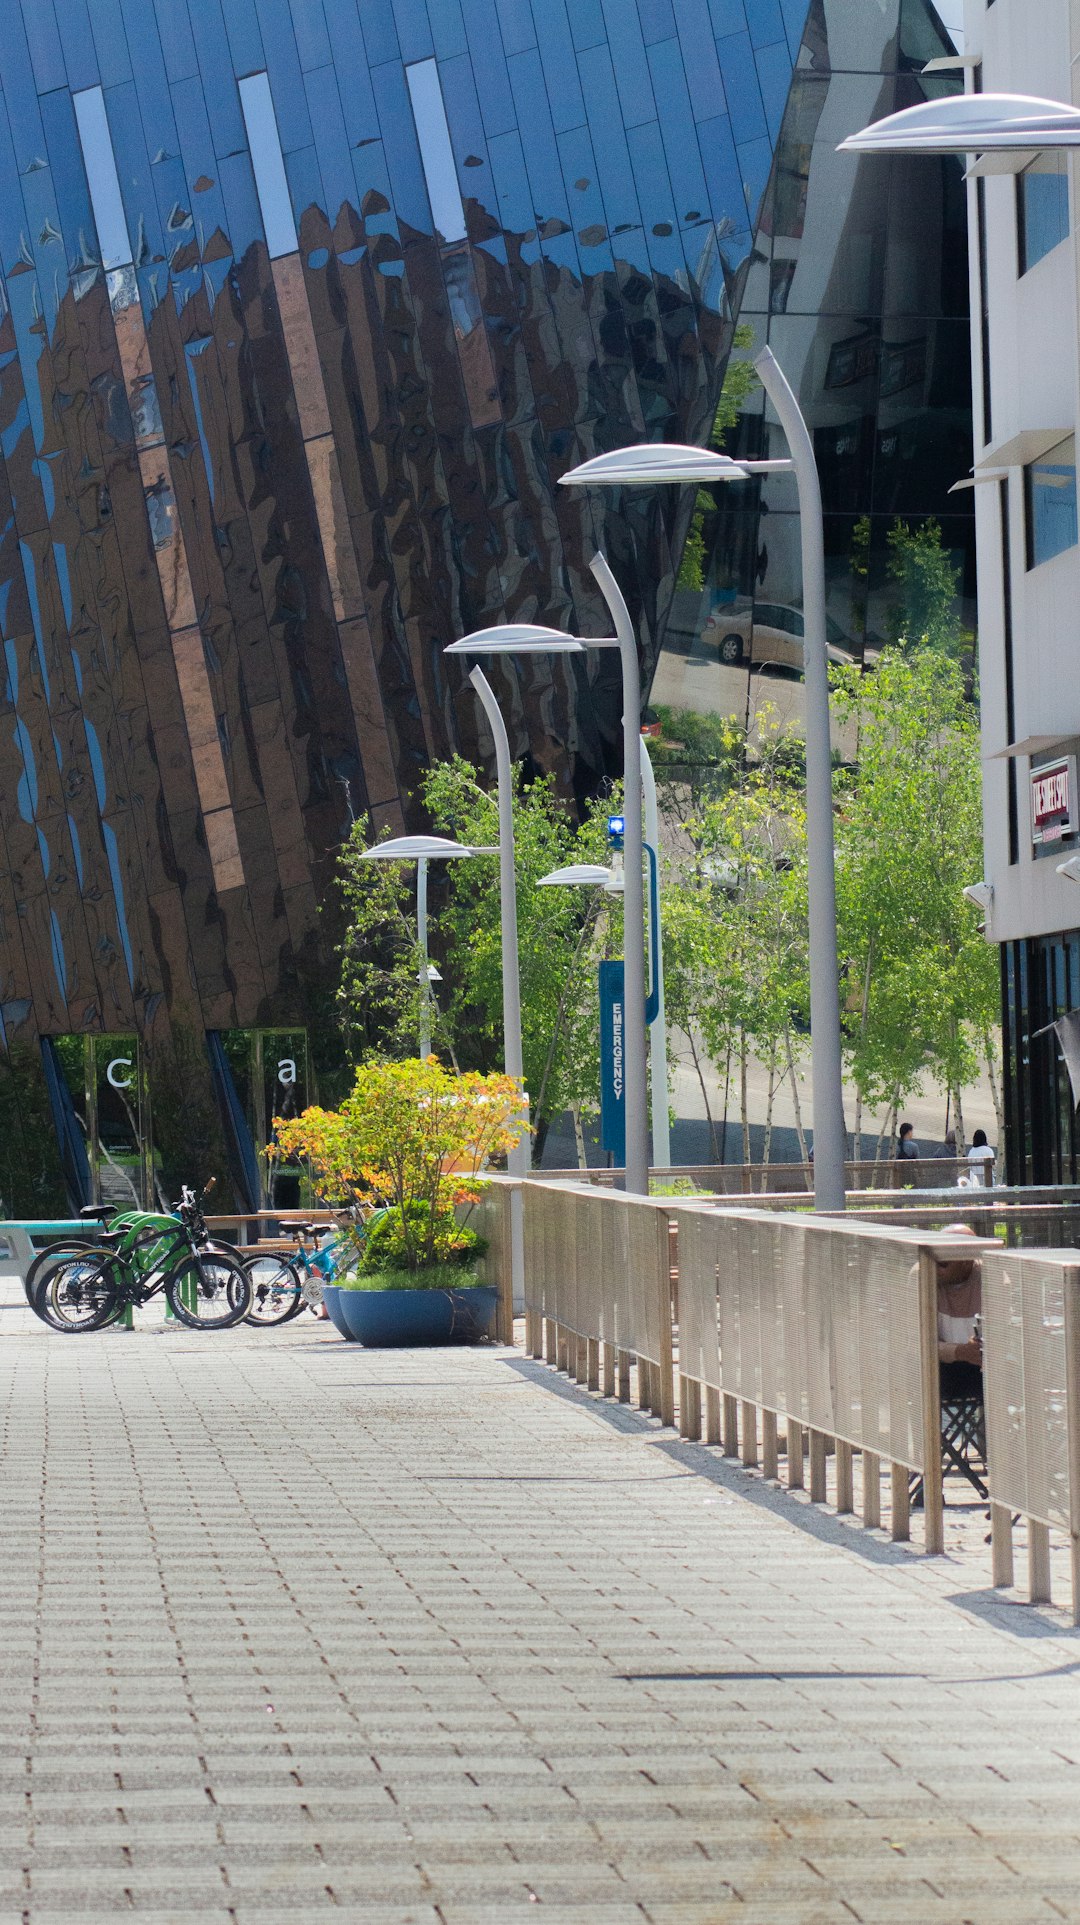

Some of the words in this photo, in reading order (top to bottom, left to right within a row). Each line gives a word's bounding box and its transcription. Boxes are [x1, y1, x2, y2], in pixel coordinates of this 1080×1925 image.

[612, 1003, 622, 1100] EMERGENCY
[277, 1058, 297, 1083] a
[58, 1261, 90, 1272] OUTROAD
[149, 1249, 170, 1272] OUTROAD
